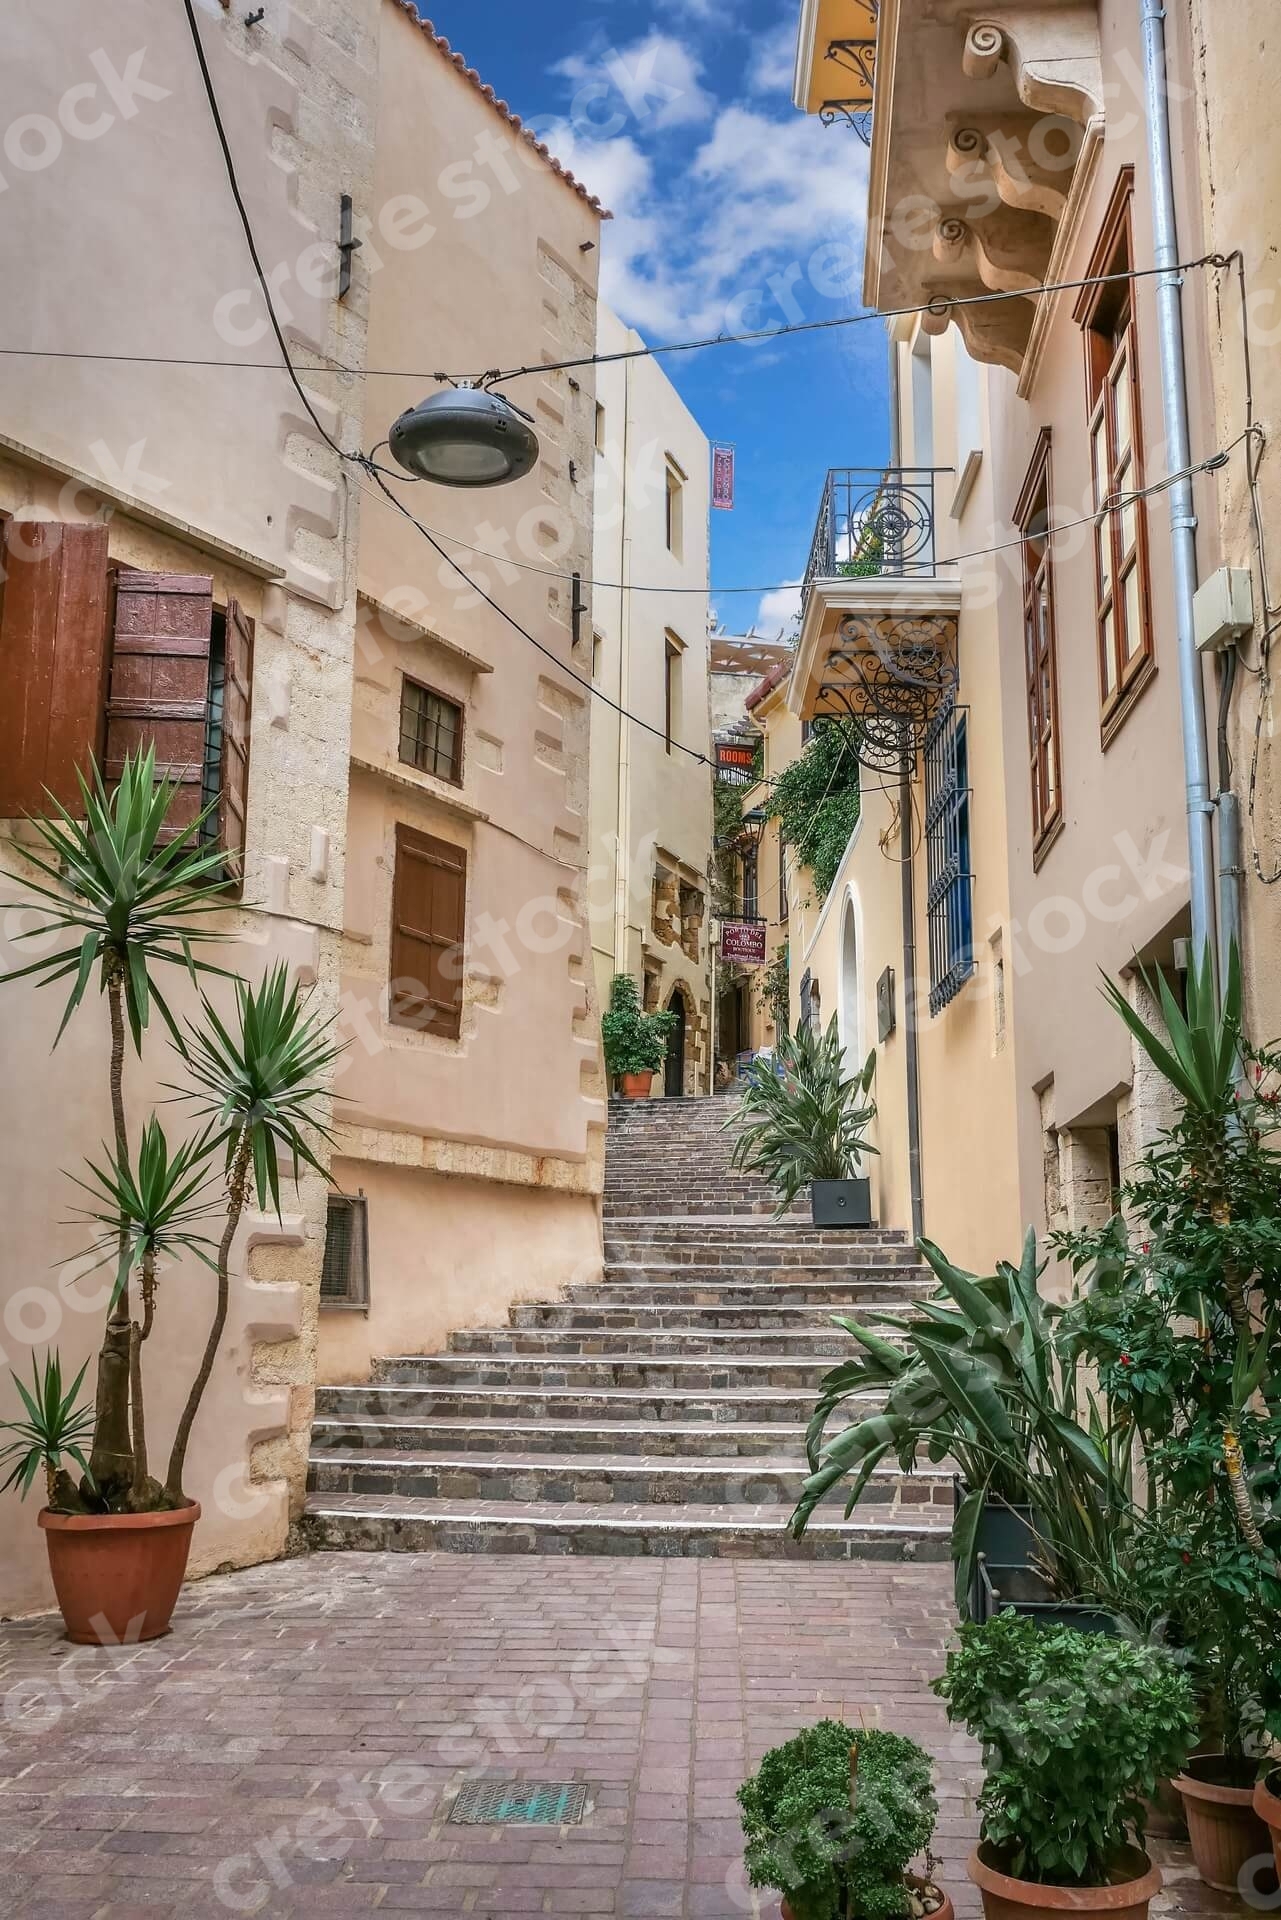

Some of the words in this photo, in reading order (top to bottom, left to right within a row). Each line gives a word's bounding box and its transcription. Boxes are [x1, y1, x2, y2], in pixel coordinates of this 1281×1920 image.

[720, 750, 752, 764] ROOMS
[725, 928, 749, 937] PORTO
[750, 929, 762, 939] DEL
[725, 938, 763, 949] COLOMBO
